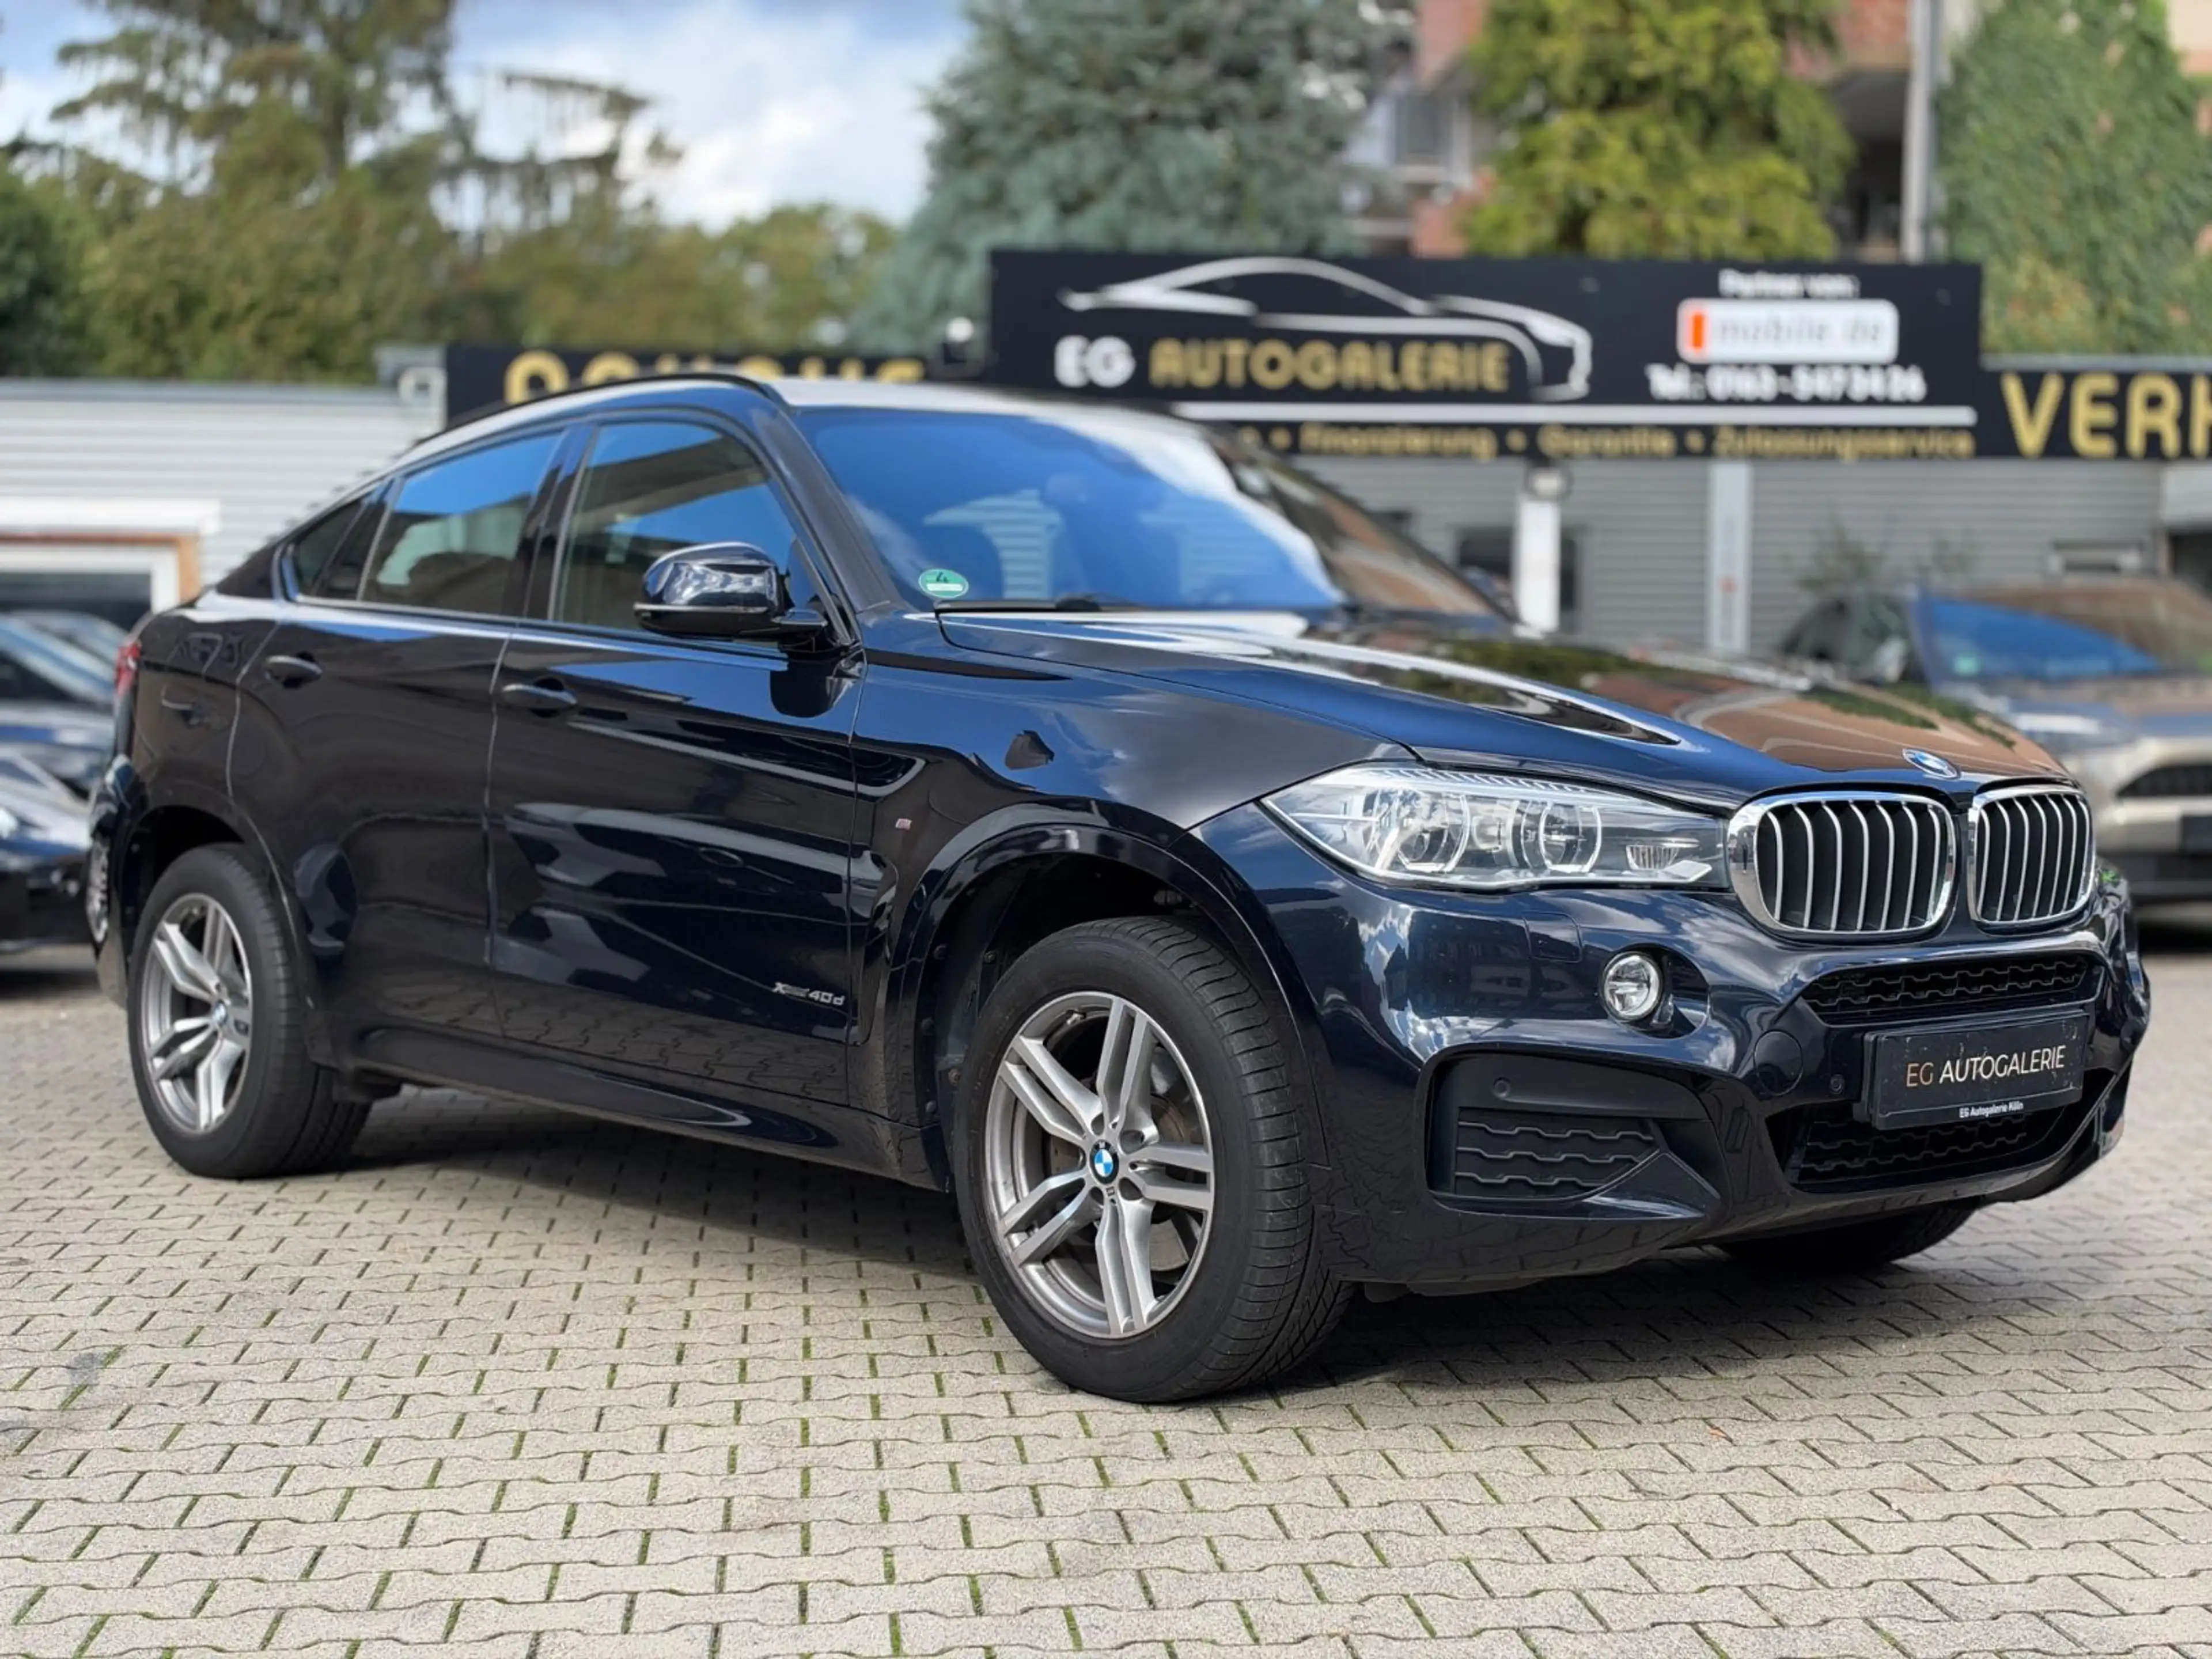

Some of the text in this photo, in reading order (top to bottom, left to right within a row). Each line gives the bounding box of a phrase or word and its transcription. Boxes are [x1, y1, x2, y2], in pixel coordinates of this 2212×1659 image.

[1055, 336, 1510, 390] EG AUTOGALERIE
[1906, 1045, 2066, 1087] EG AUTOGALERIE
